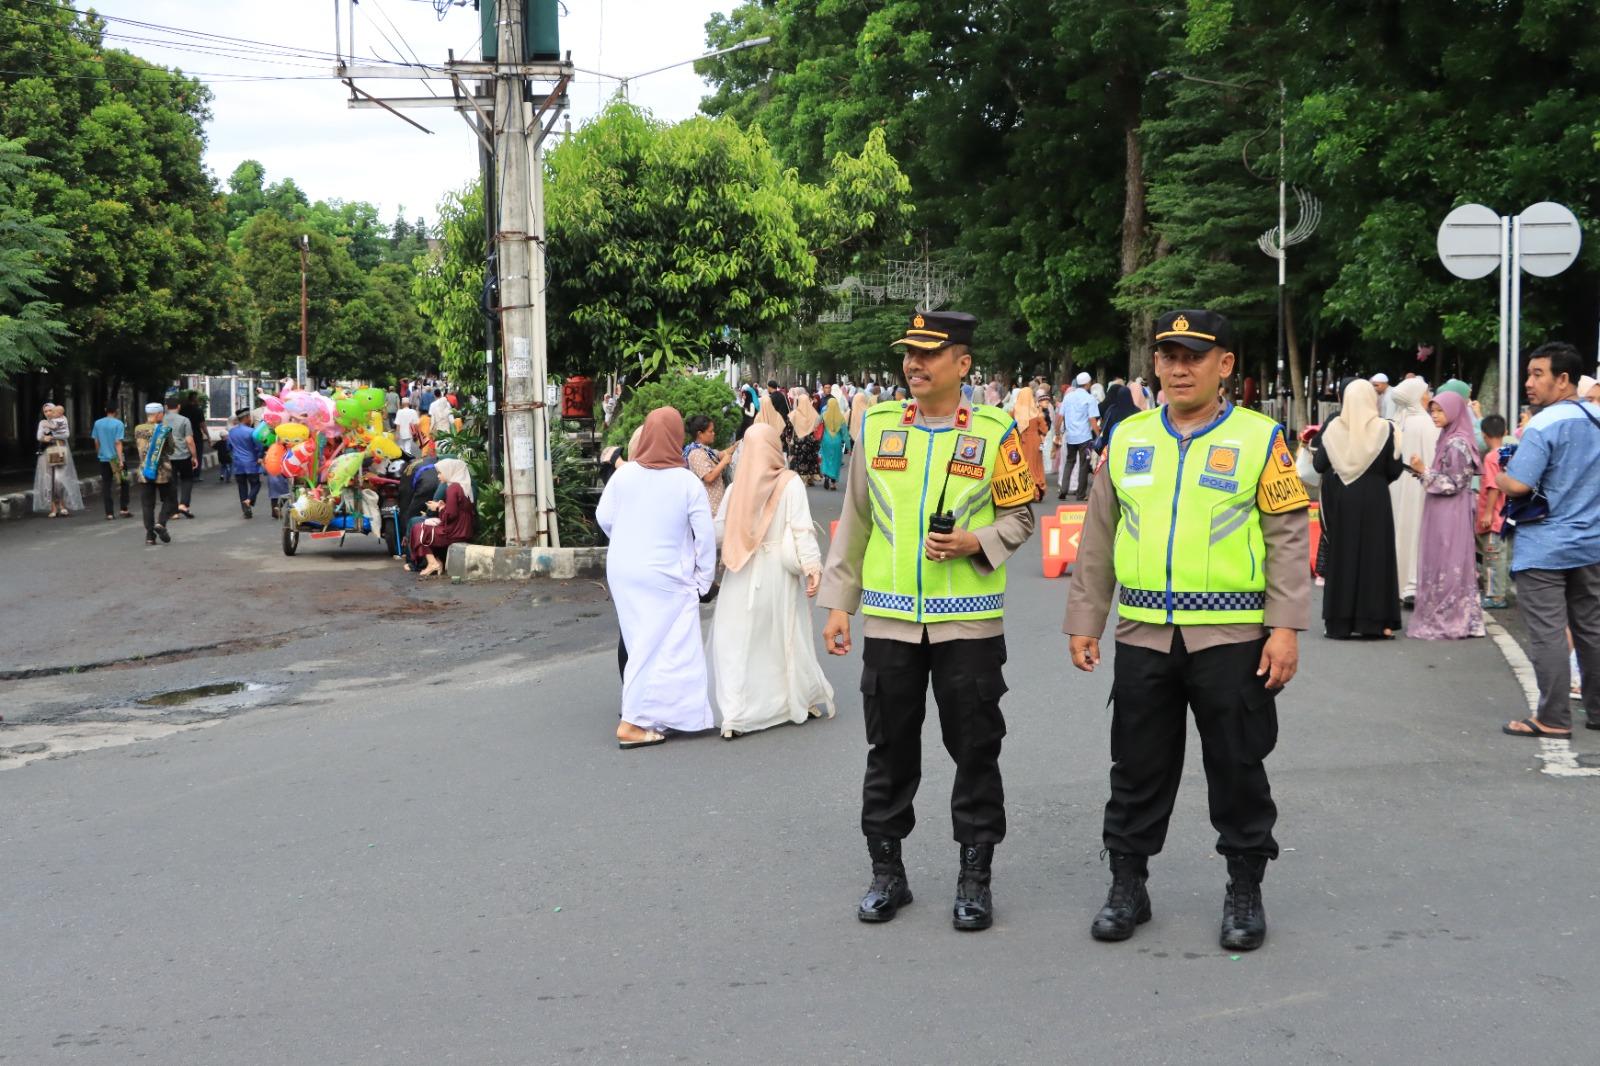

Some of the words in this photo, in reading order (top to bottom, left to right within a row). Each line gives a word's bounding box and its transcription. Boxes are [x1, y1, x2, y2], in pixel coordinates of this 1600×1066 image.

[992, 475, 1021, 501] WAKA
[1200, 476, 1236, 491] POLRI
[1265, 475, 1300, 505] KADATA
